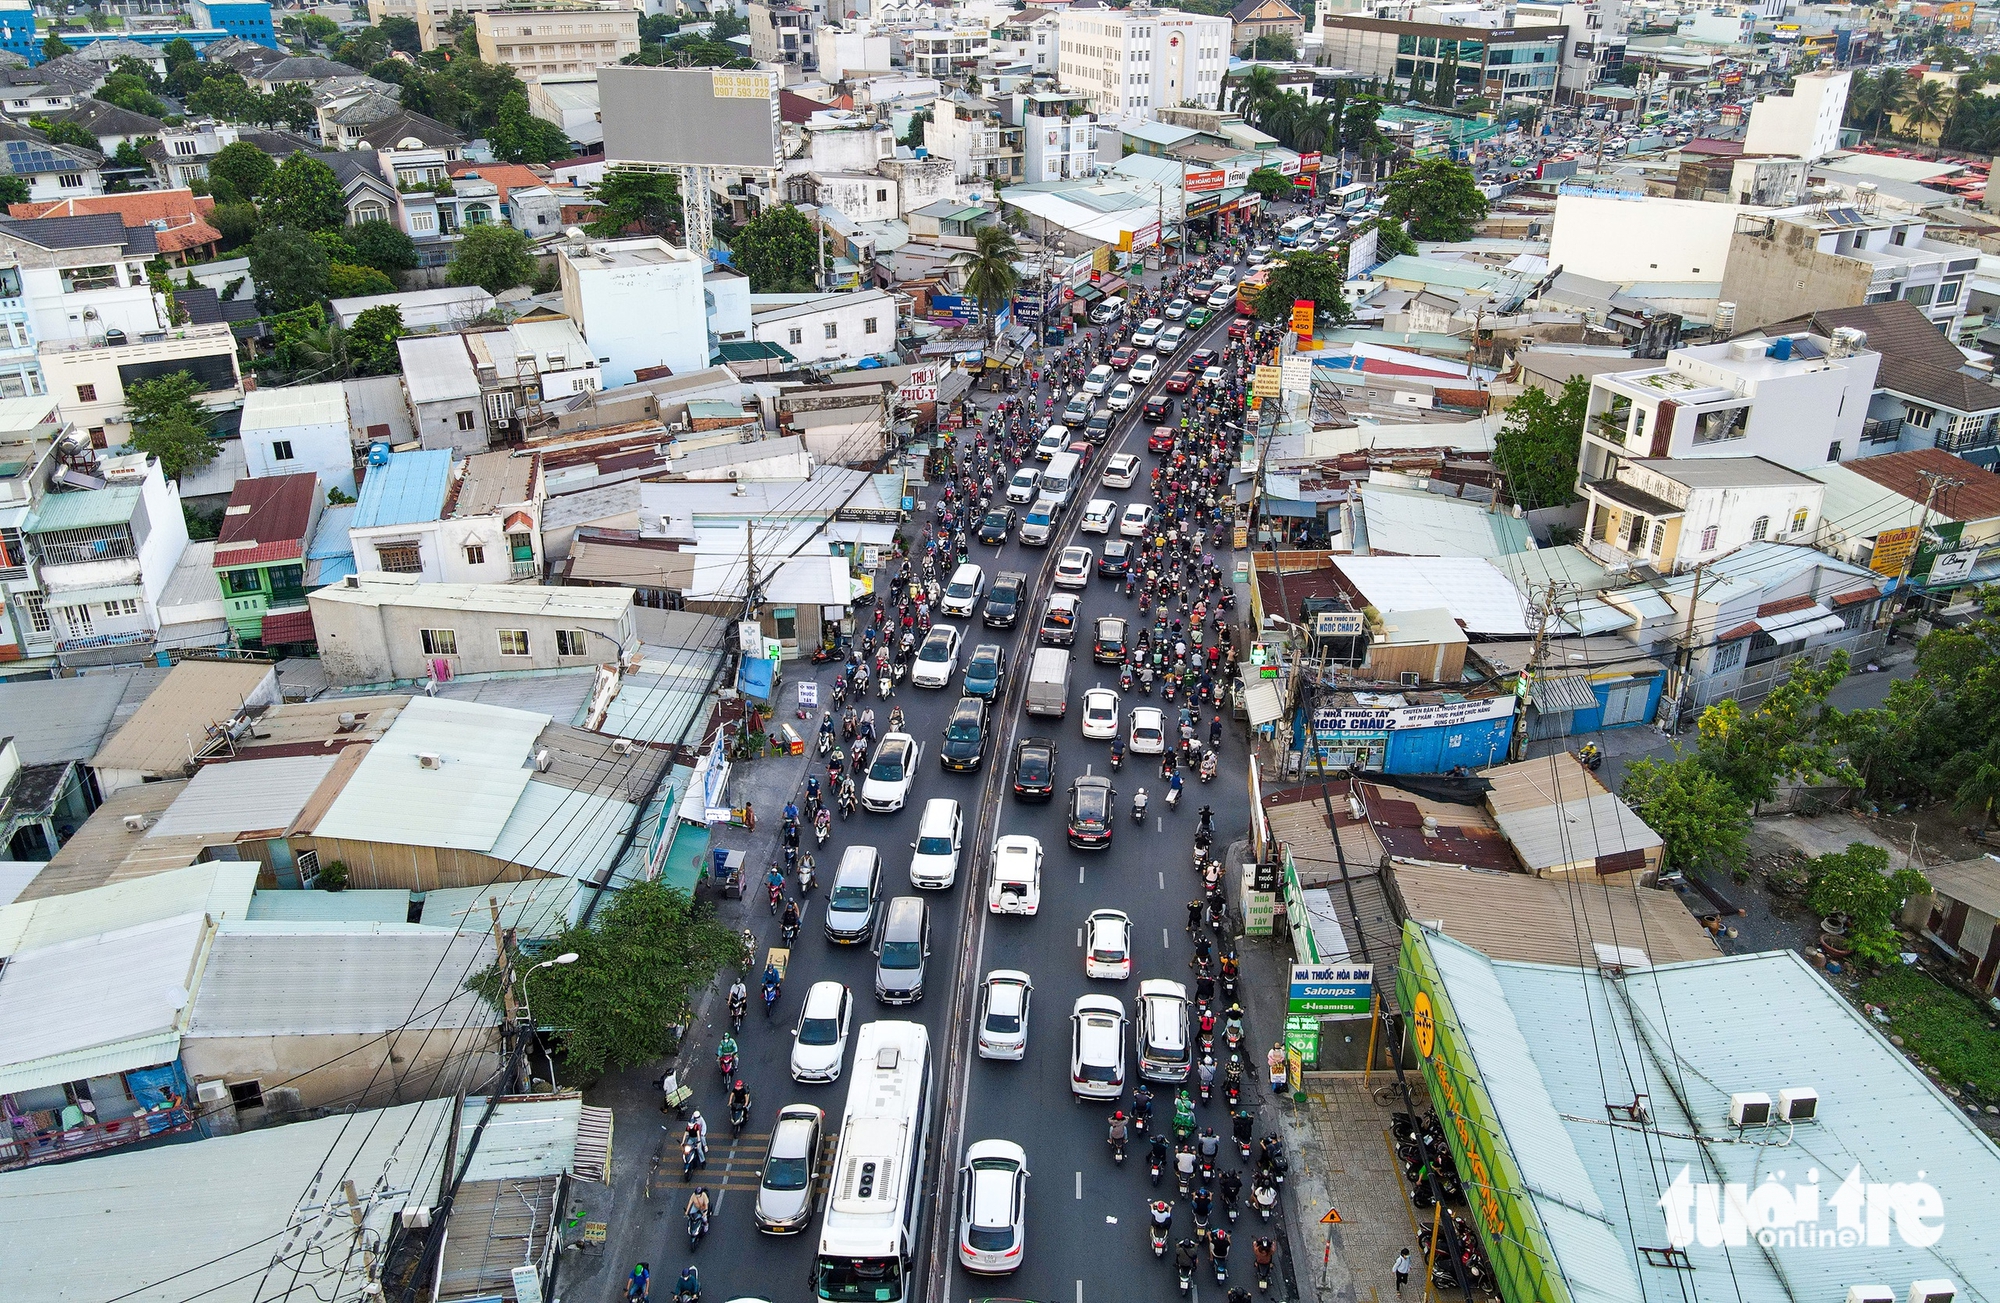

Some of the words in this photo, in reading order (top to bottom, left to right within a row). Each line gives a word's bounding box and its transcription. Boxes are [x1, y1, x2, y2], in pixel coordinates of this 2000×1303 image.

[713, 76, 769, 88] 0903.940.018
[714, 87, 769, 98] 0907.593.222
[1229, 171, 1246, 182] Ferroli
[1319, 623, 1336, 634] NGỌC
[1337, 622, 1354, 632] CHÂU
[1354, 624, 1361, 632] 2
[1323, 709, 1342, 718] NHÀ
[1344, 709, 1373, 718] THUỐC
[1374, 710, 1390, 718] TÂY
[1450, 709, 1464, 717] PHẨM
[1313, 718, 1346, 731] NGỌC
[1350, 717, 1384, 729] CHÂU
[1385, 719, 1397, 729] 2
[1249, 904, 1273, 914] THUỐC
[1254, 917, 1268, 925] TÂY
[1295, 969, 1309, 980] NHÀ
[1312, 968, 1335, 980] THUỐC
[1337, 969, 1351, 980] HÒA
[1354, 969, 1370, 980] BÌNH
[1304, 987, 1356, 997] Salonpas
[1435, 1054, 1454, 1109] Bách
